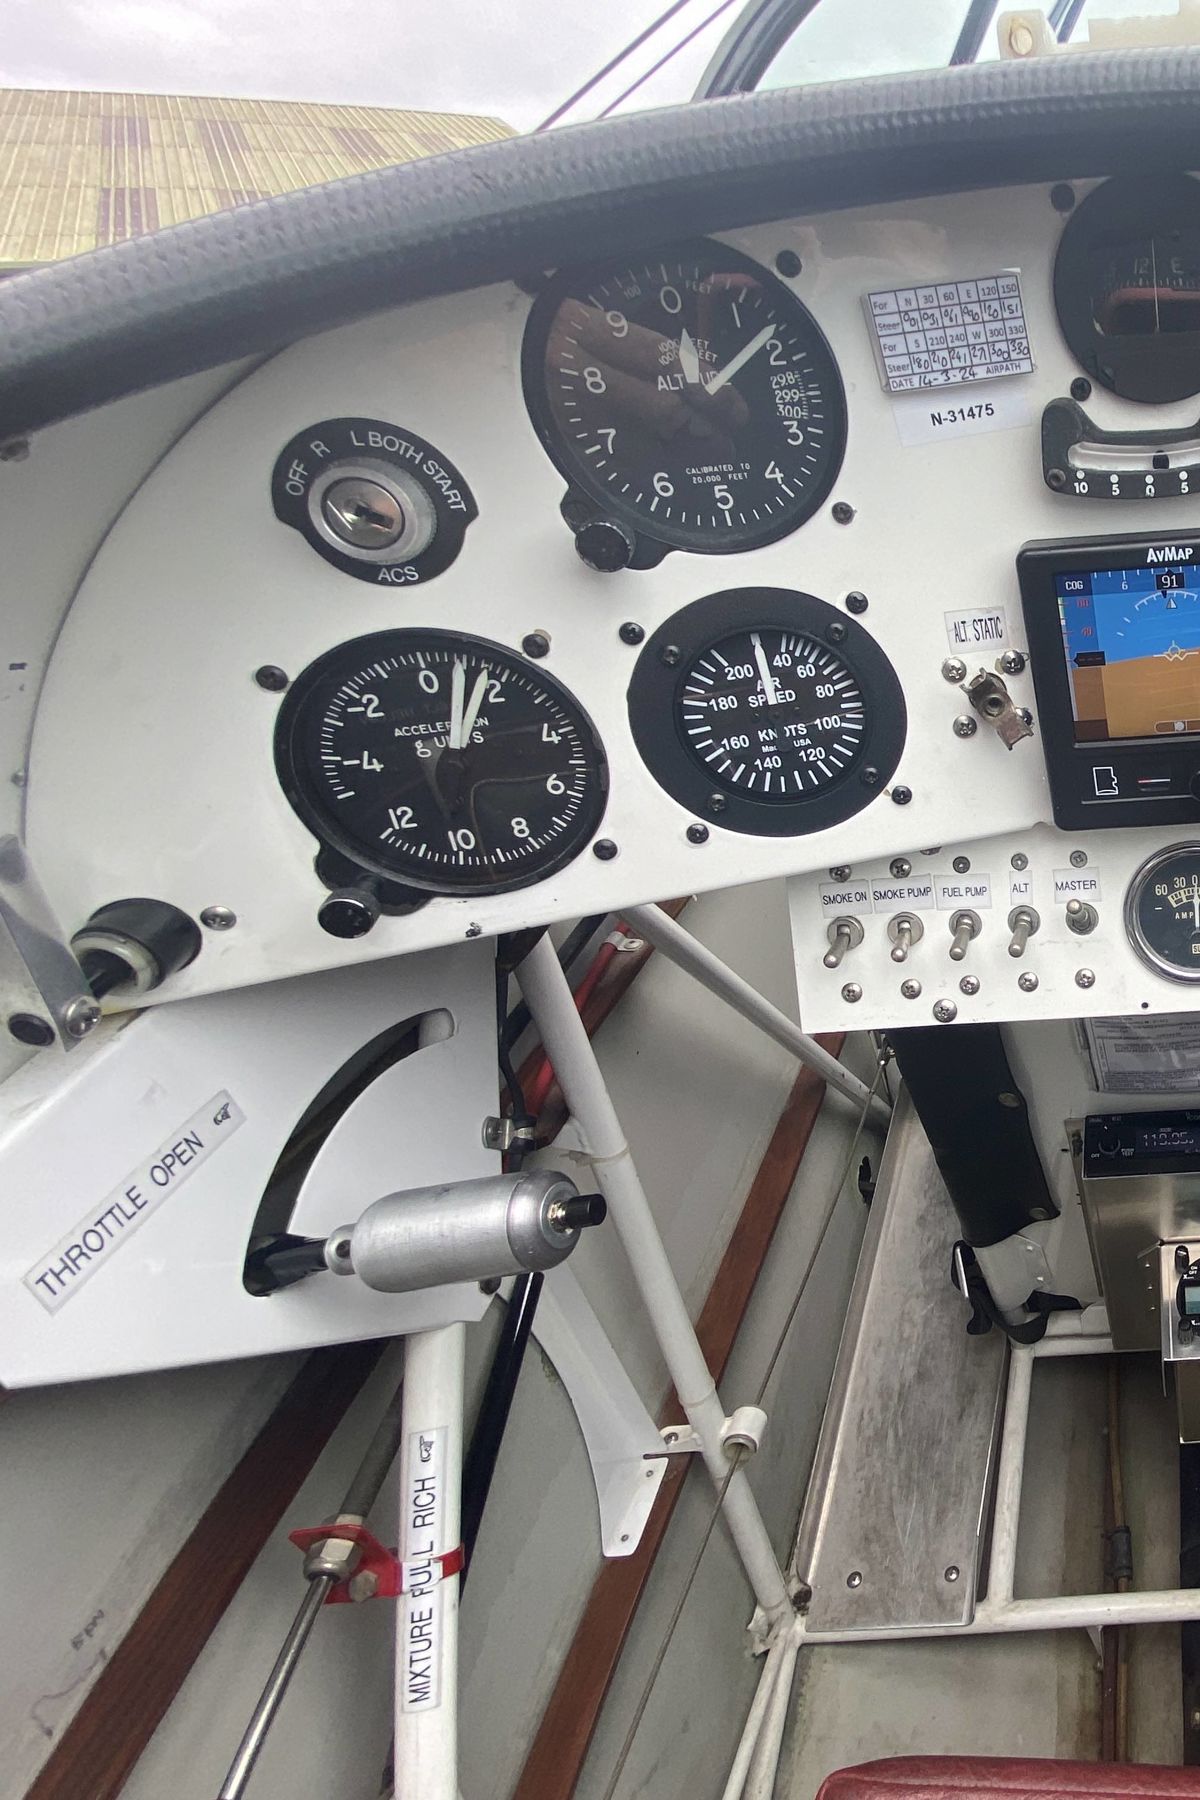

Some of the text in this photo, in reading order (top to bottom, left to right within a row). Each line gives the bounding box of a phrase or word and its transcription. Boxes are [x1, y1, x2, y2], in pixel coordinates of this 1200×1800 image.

[660, 286, 682, 313] 0
[873, 284, 1016, 310] For 30 60 120 150
[606, 311, 628, 337] 9
[883, 325, 1024, 352] For 210 240 300 330
[766, 339, 786, 366] 2
[888, 362, 910, 373] Steer
[892, 363, 1021, 388] DATE AIRPATH
[583, 367, 606, 394] 8
[931, 403, 994, 426] N-31475
[597, 428, 616, 454] 7
[783, 421, 803, 445] 3
[285, 430, 466, 512] OFF R L BOTH START
[686, 465, 734, 475] CALIBRATED
[728, 473, 748, 481] FEET
[653, 461, 783, 509] 6 5 4
[1074, 482, 1088, 493] 10
[1112, 484, 1119, 495] 5
[1181, 482, 1188, 493] 5
[378, 566, 419, 583] ACS
[1122, 582, 1128, 590] 6
[1161, 576, 1178, 588] 91
[1066, 581, 1083, 590] COG
[954, 616, 1002, 643] ALT. STATIC
[725, 664, 754, 681] 200
[773, 654, 815, 677] 40 60
[418, 670, 505, 703] 0 2
[816, 684, 834, 698] 80
[709, 697, 738, 711] 180
[814, 715, 841, 730] 100
[542, 723, 561, 744] 4
[721, 735, 749, 751] 160
[793, 738, 811, 748] USA
[755, 747, 826, 771] 140 120
[547, 774, 565, 794] 6
[388, 806, 529, 851] 12 10 8
[874, 886, 932, 900] SMOKE PUMP
[942, 886, 987, 897] FUEL PUMP
[1012, 883, 1029, 893] ALT
[1056, 880, 1096, 891] MASTER
[1156, 885, 1167, 895] 60
[1174, 877, 1186, 888] 30
[823, 891, 867, 906] SMOKE ON
[35, 1130, 205, 1296] THROTTLE OPEN
[409, 1476, 436, 1703] MIXTURE FULL RICH
